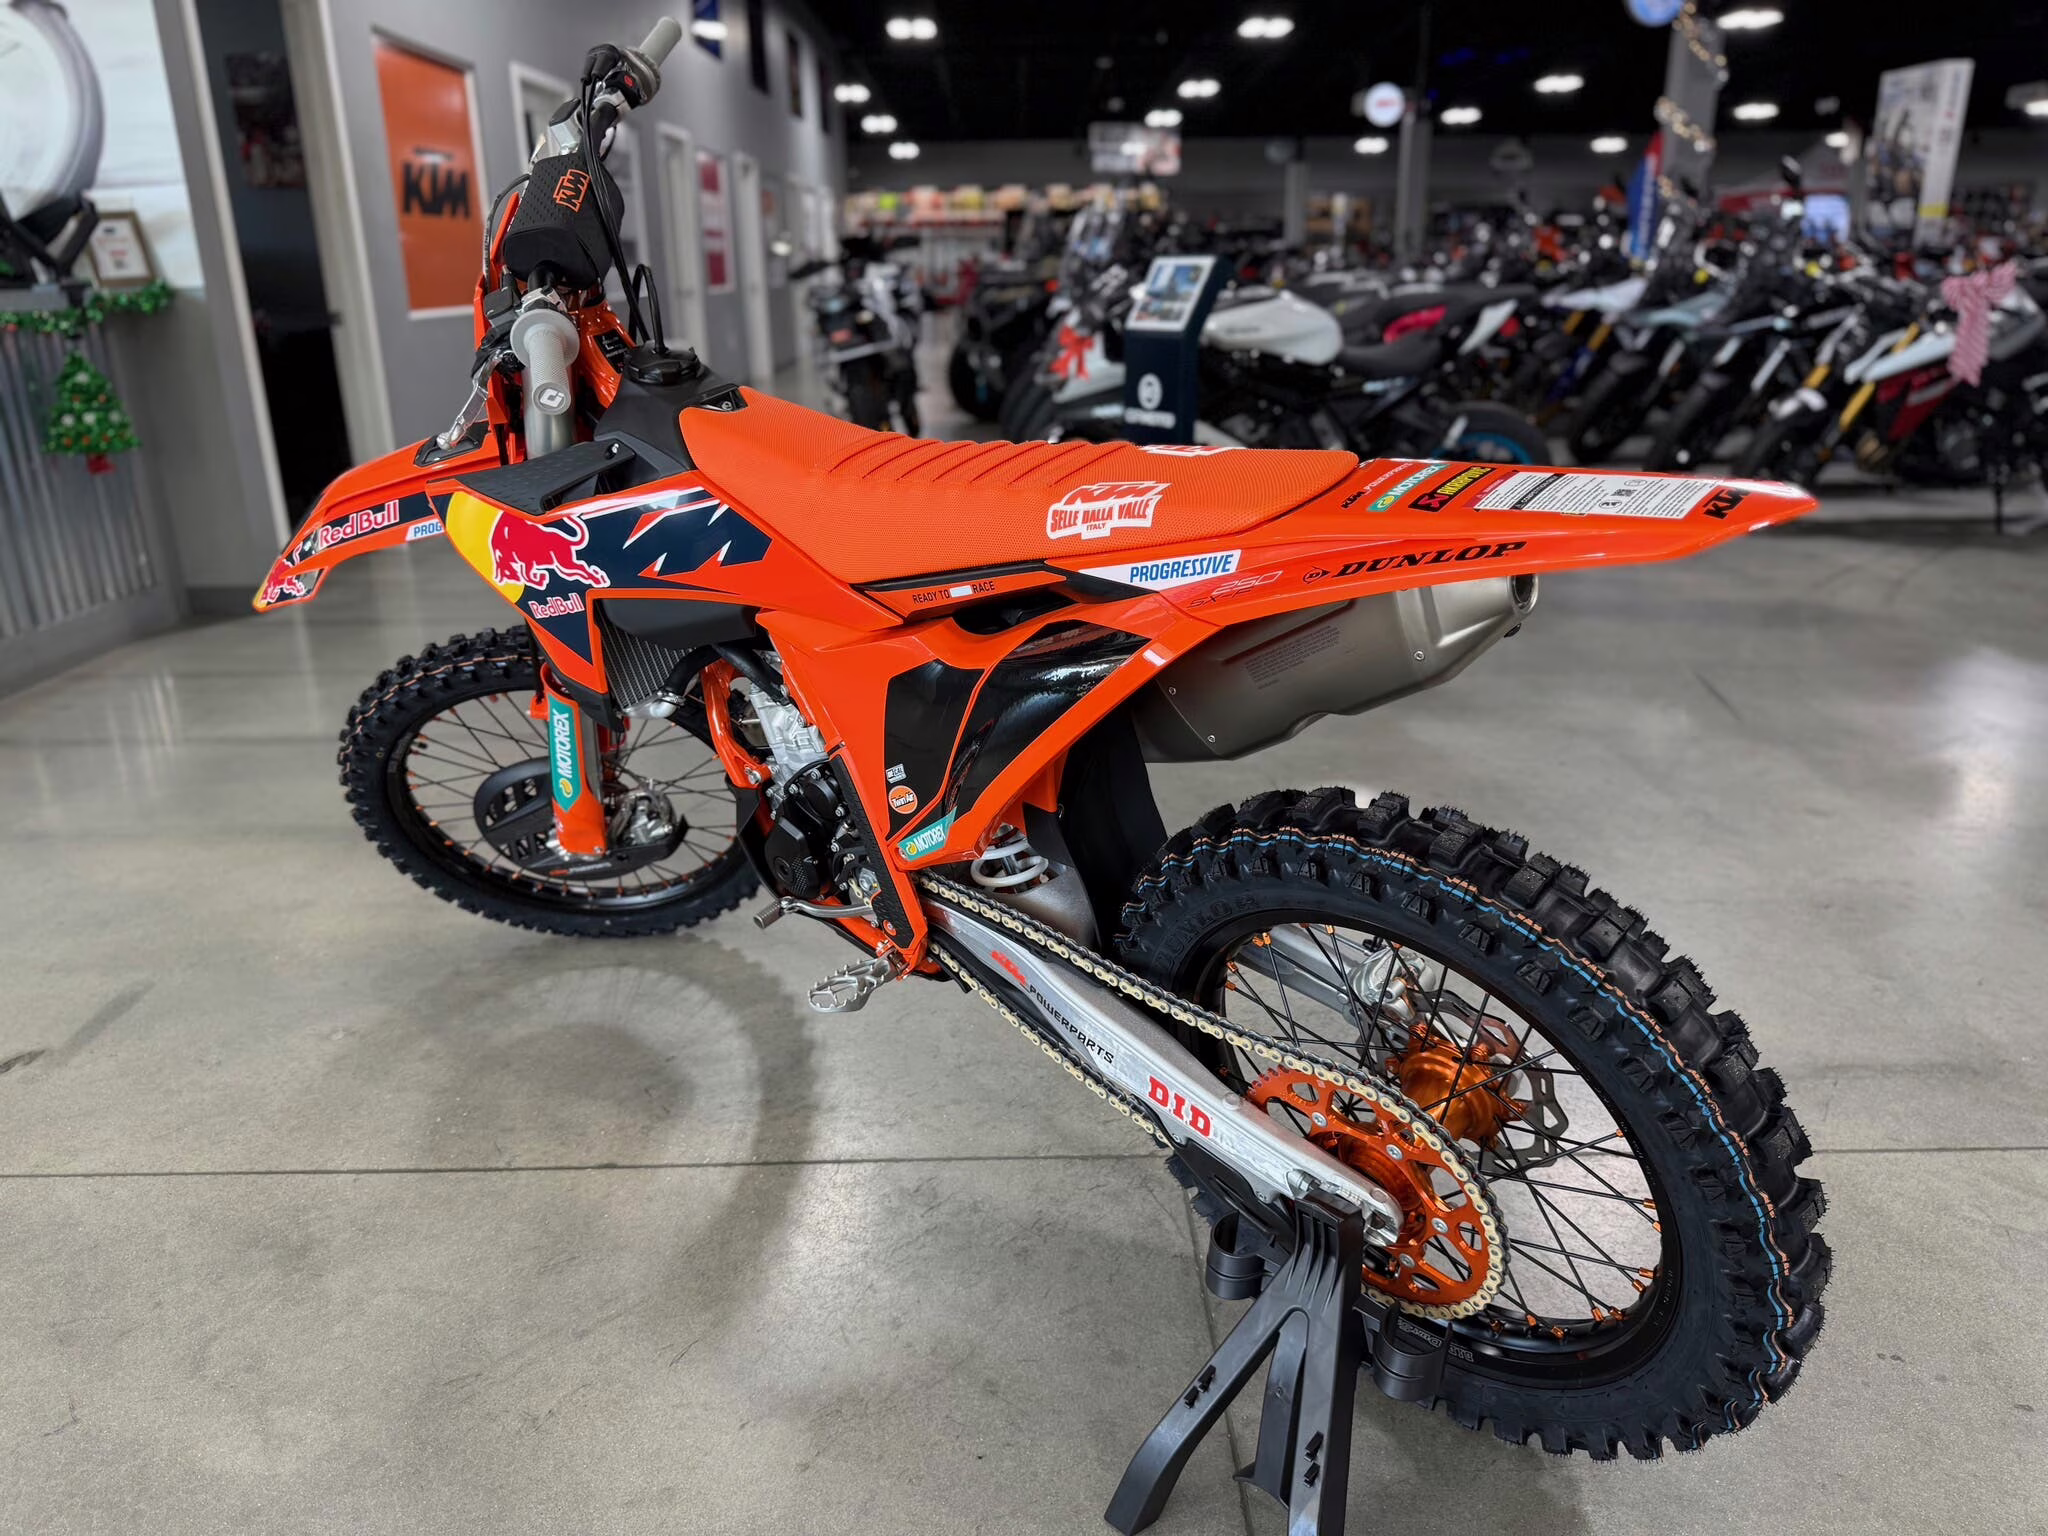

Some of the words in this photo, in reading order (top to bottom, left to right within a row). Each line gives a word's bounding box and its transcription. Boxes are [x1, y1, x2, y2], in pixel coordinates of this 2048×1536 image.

[402, 148, 471, 219] KTM
[553, 168, 591, 213] KTM
[1388, 464, 1441, 496] MOTOREX
[1050, 509, 1079, 533] SELLE
[1082, 504, 1114, 524] DALLA
[1117, 500, 1151, 520] VALLE
[1086, 522, 1107, 532] ITALY
[1130, 553, 1234, 583] PROGRESSIVE
[1331, 541, 1528, 579] DUNLOP
[912, 590, 938, 605] READY
[939, 588, 951, 600] TO
[971, 580, 996, 595] RACE
[1210, 569, 1284, 596] 250
[552, 707, 573, 779] MOTOREX
[913, 823, 946, 853] MOTOREX
[1028, 983, 1115, 1065] POWERPARTS
